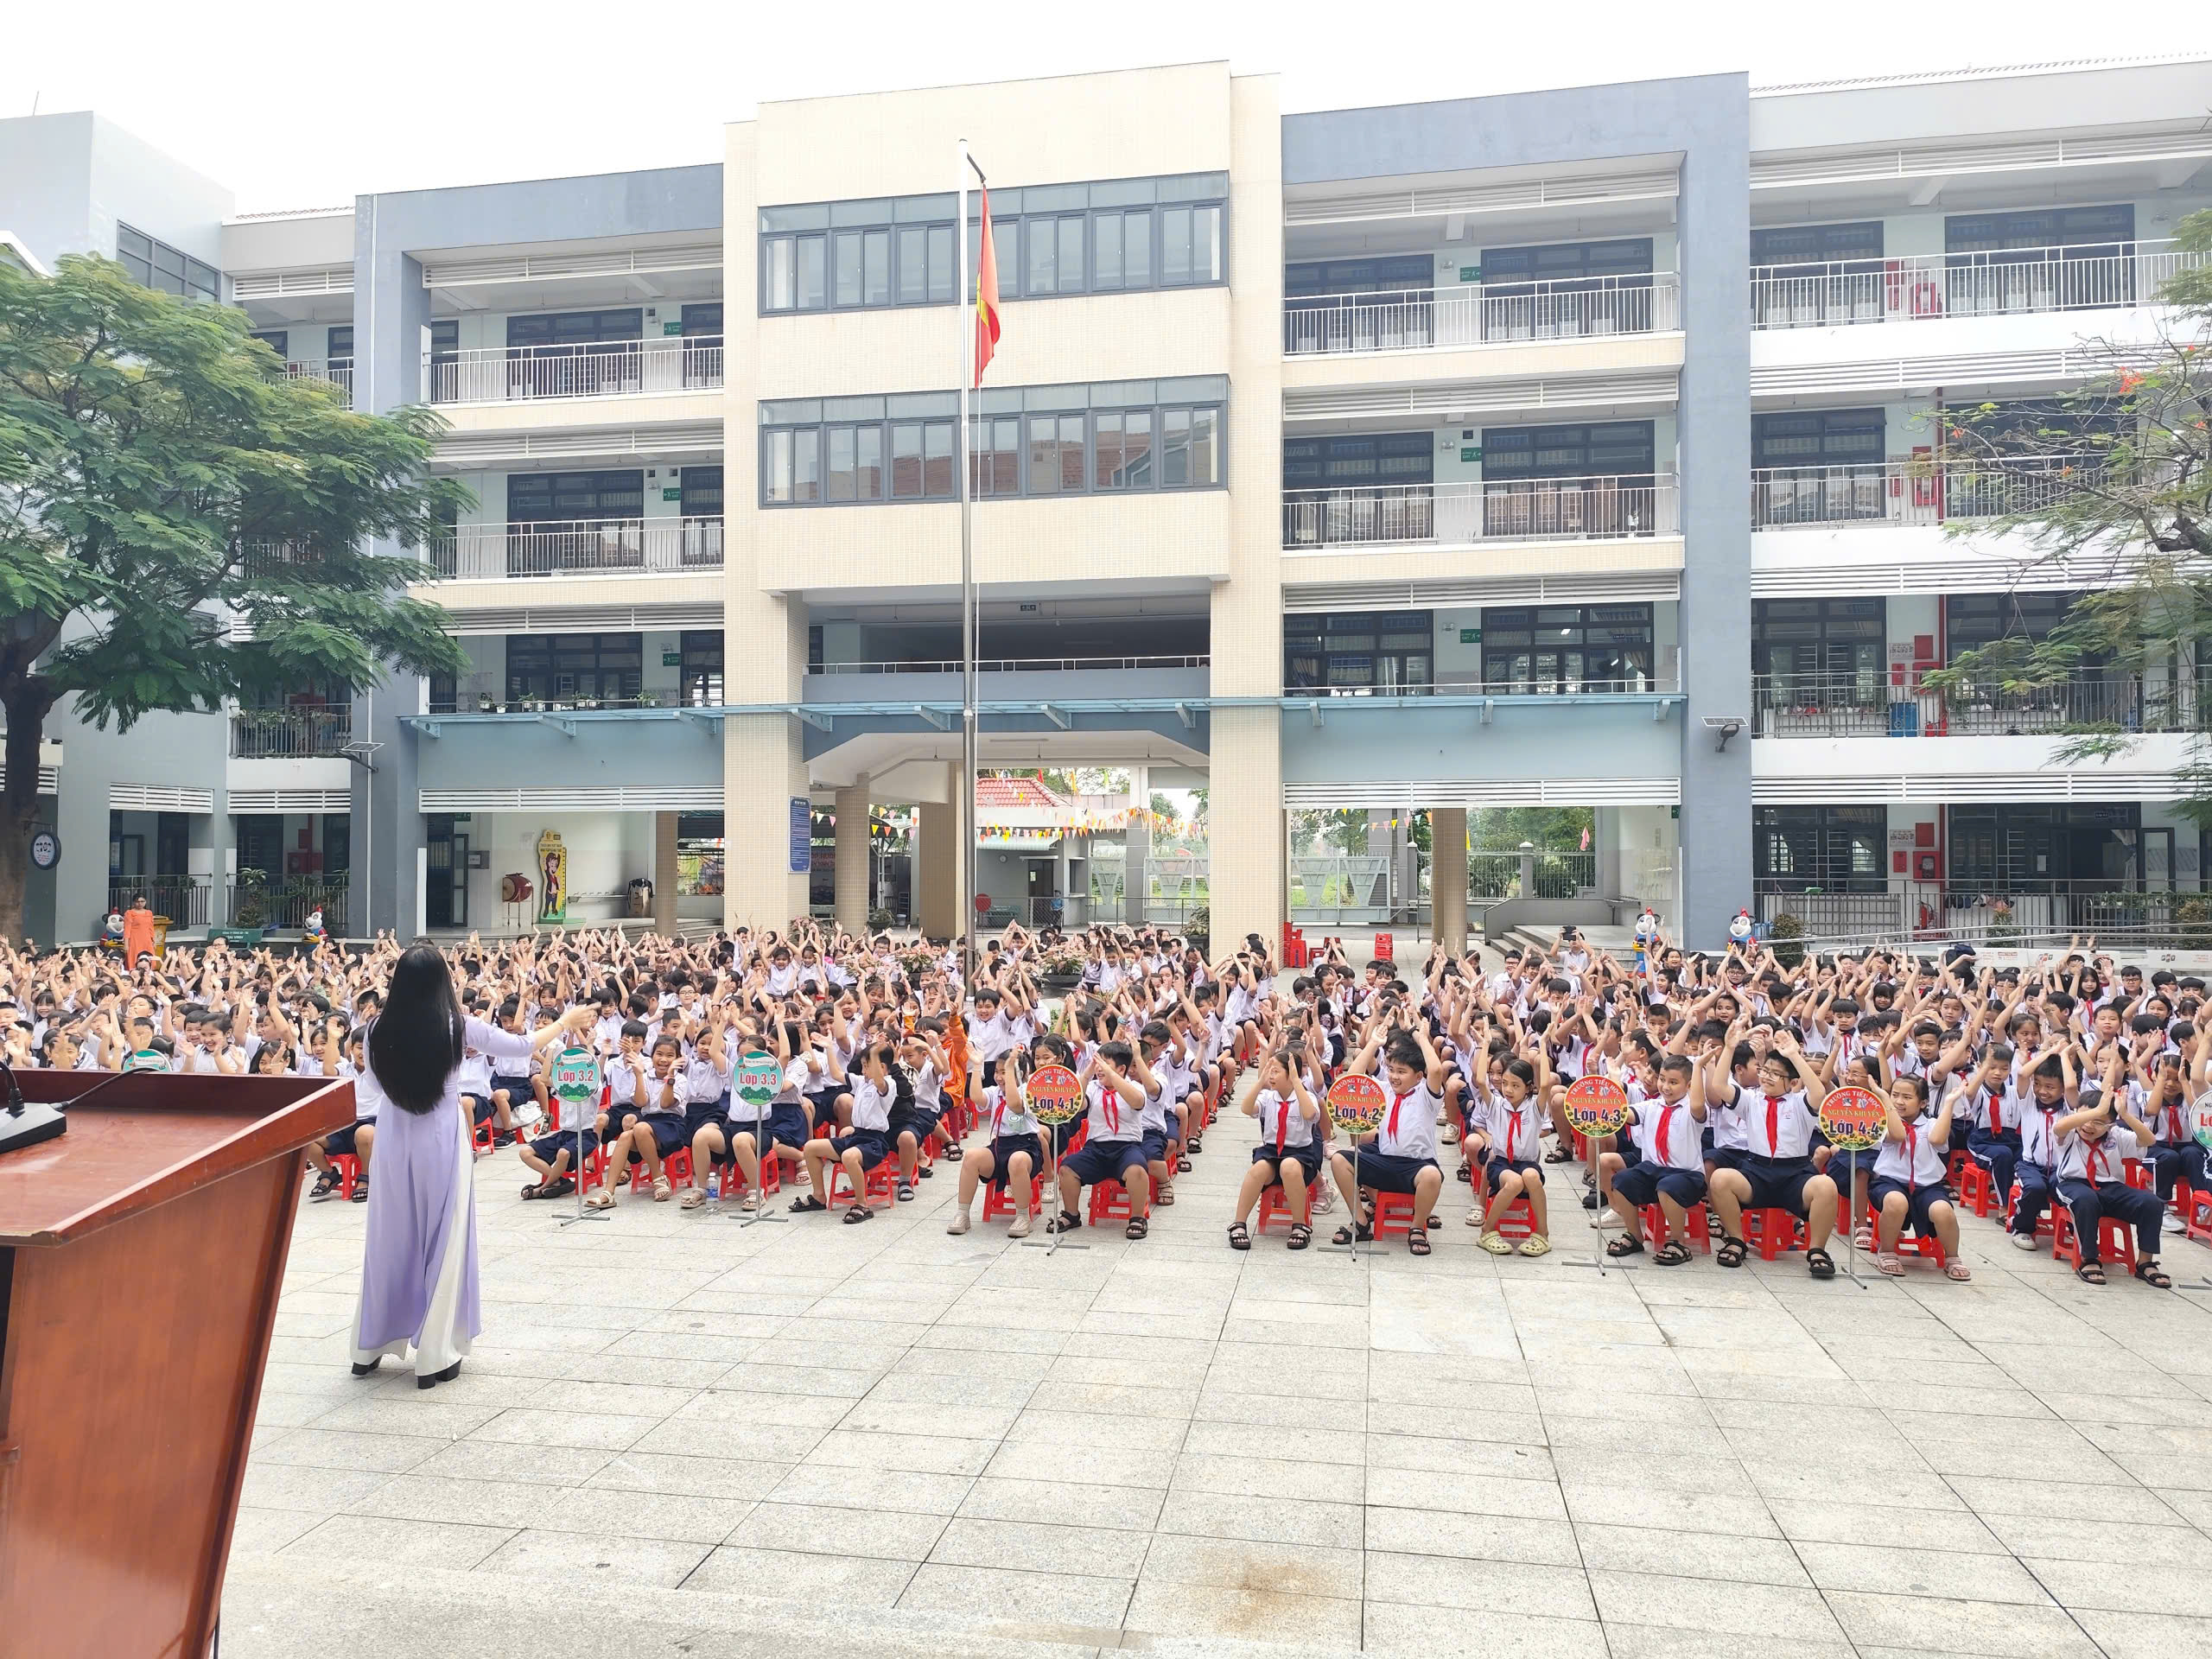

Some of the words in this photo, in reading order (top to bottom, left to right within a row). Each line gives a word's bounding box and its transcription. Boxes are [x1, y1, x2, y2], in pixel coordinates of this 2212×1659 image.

[558, 1070, 575, 1083] Lớp
[578, 1070, 594, 1082] 3.2
[740, 1071, 758, 1086] Lớp
[760, 1073, 777, 1085] 3.3
[1033, 1096, 1054, 1110] Lớp
[1058, 1096, 1074, 1109] 4.1
[1826, 1090, 1851, 1107] TRƯỜNG
[1335, 1105, 1357, 1120] Lớp
[1360, 1107, 1380, 1120] 4.2
[1573, 1108, 1597, 1122] Lớp
[1601, 1109, 1621, 1122] 4.3
[1829, 1119, 1853, 1135] Lớp
[1859, 1121, 1879, 1135] 4.4
